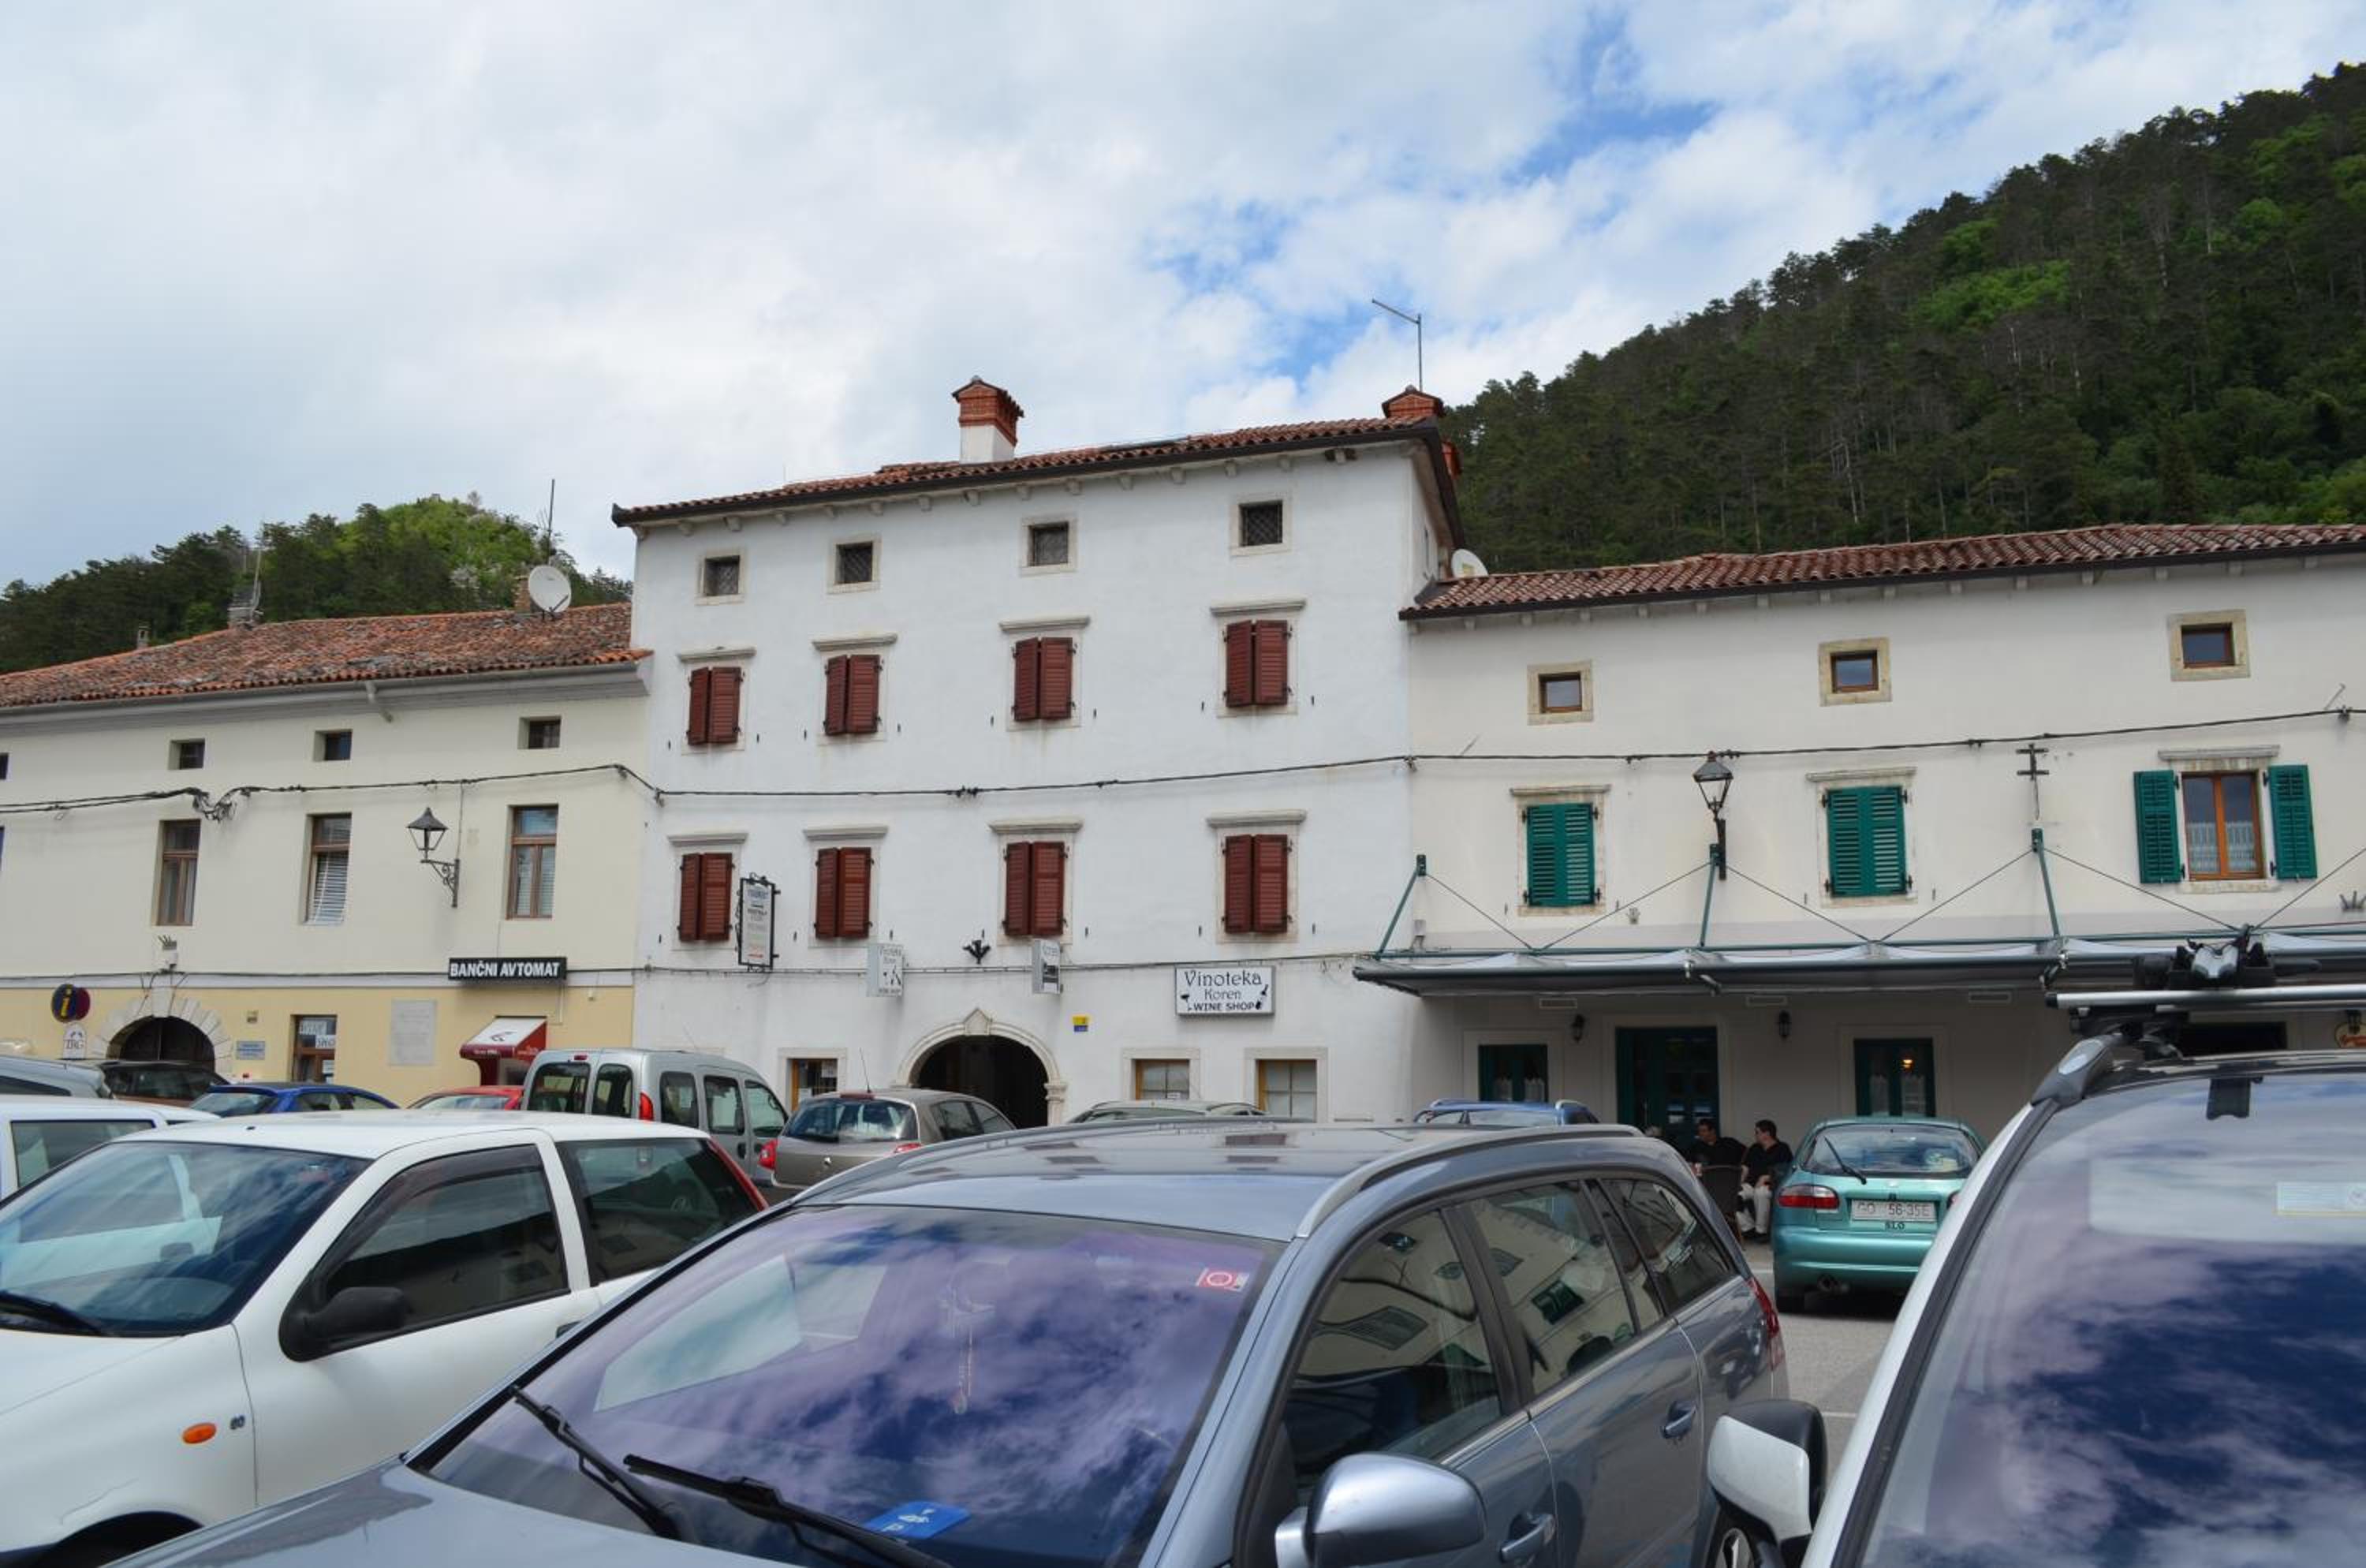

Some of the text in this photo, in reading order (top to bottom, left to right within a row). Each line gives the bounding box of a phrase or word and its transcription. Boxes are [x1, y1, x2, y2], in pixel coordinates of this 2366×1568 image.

[450, 960, 560, 977] BANČNI AVTOMAT
[1185, 970, 1262, 987] Vinoteka
[1204, 988, 1241, 1000] Koren
[1226, 1001, 1255, 1010] SHOP
